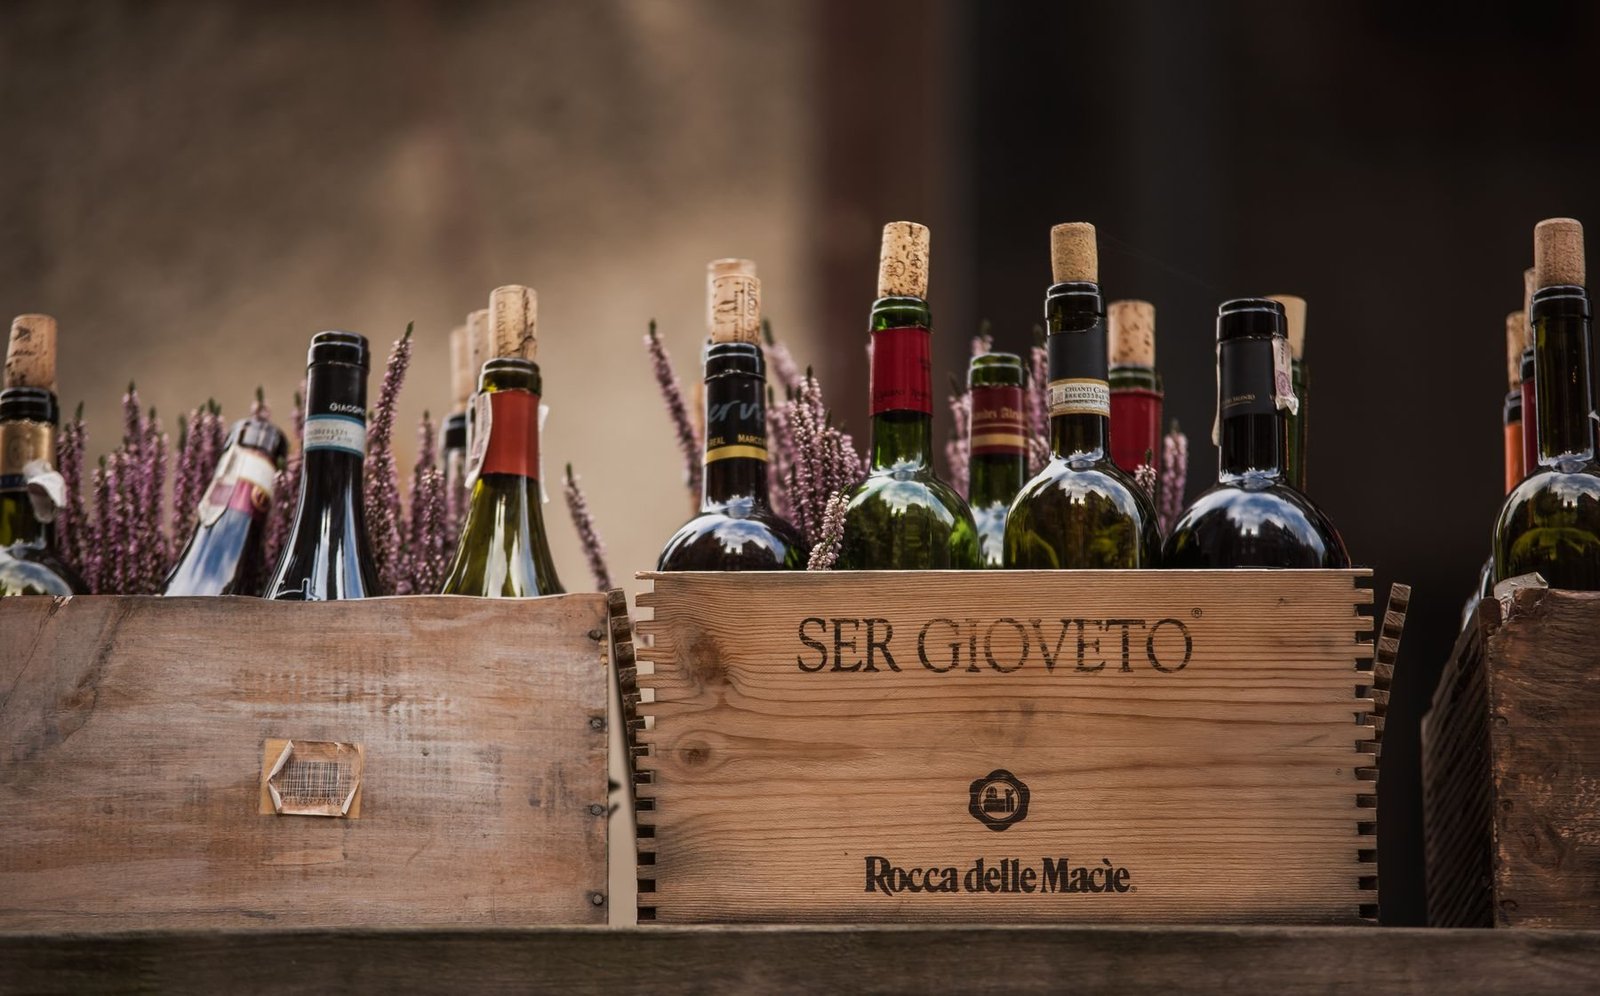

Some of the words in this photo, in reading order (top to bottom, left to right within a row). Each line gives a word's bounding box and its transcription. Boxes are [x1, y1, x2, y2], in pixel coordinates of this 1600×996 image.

[797, 617, 903, 673] SER
[918, 617, 1192, 673] GIOVETO
[864, 856, 960, 896] Rocca
[964, 857, 1037, 893] delle
